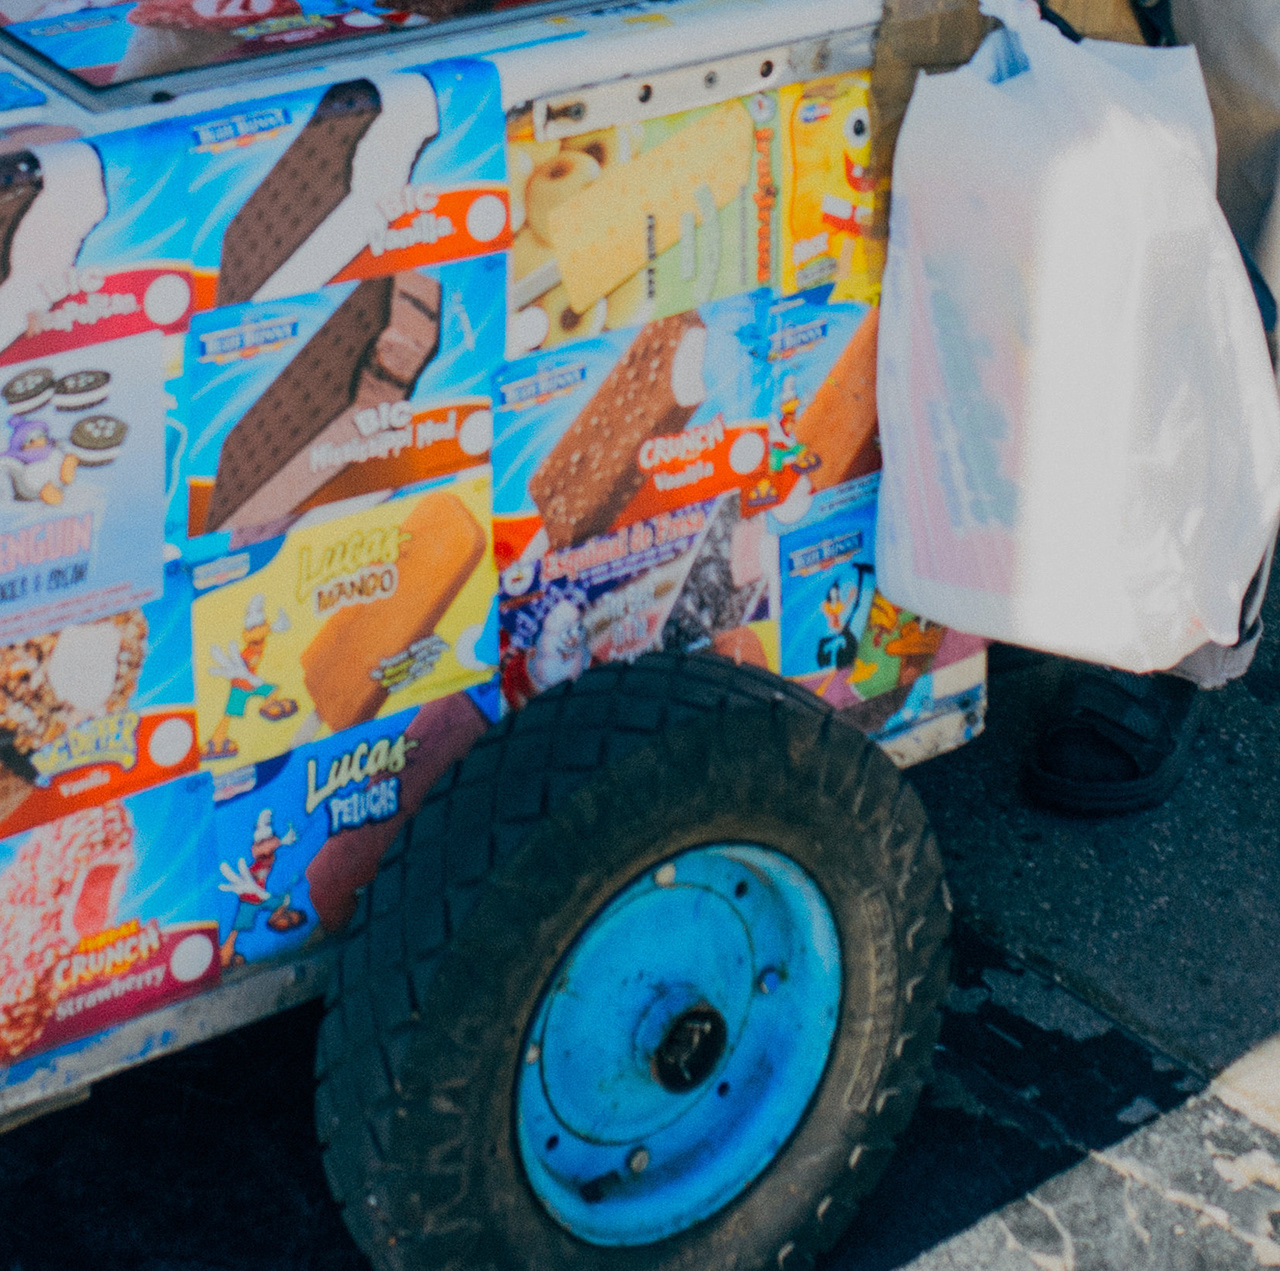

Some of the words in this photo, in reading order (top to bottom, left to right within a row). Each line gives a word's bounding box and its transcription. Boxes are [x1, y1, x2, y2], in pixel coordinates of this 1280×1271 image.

[354, 400, 413, 436] BIG
[638, 415, 725, 470] CRUNCH
[295, 524, 412, 604] Lucas
[317, 568, 394, 612] MANGO
[305, 735, 418, 814] Lucas
[330, 778, 398, 831] PELUCAS
[53, 921, 160, 990] CRUNCH
